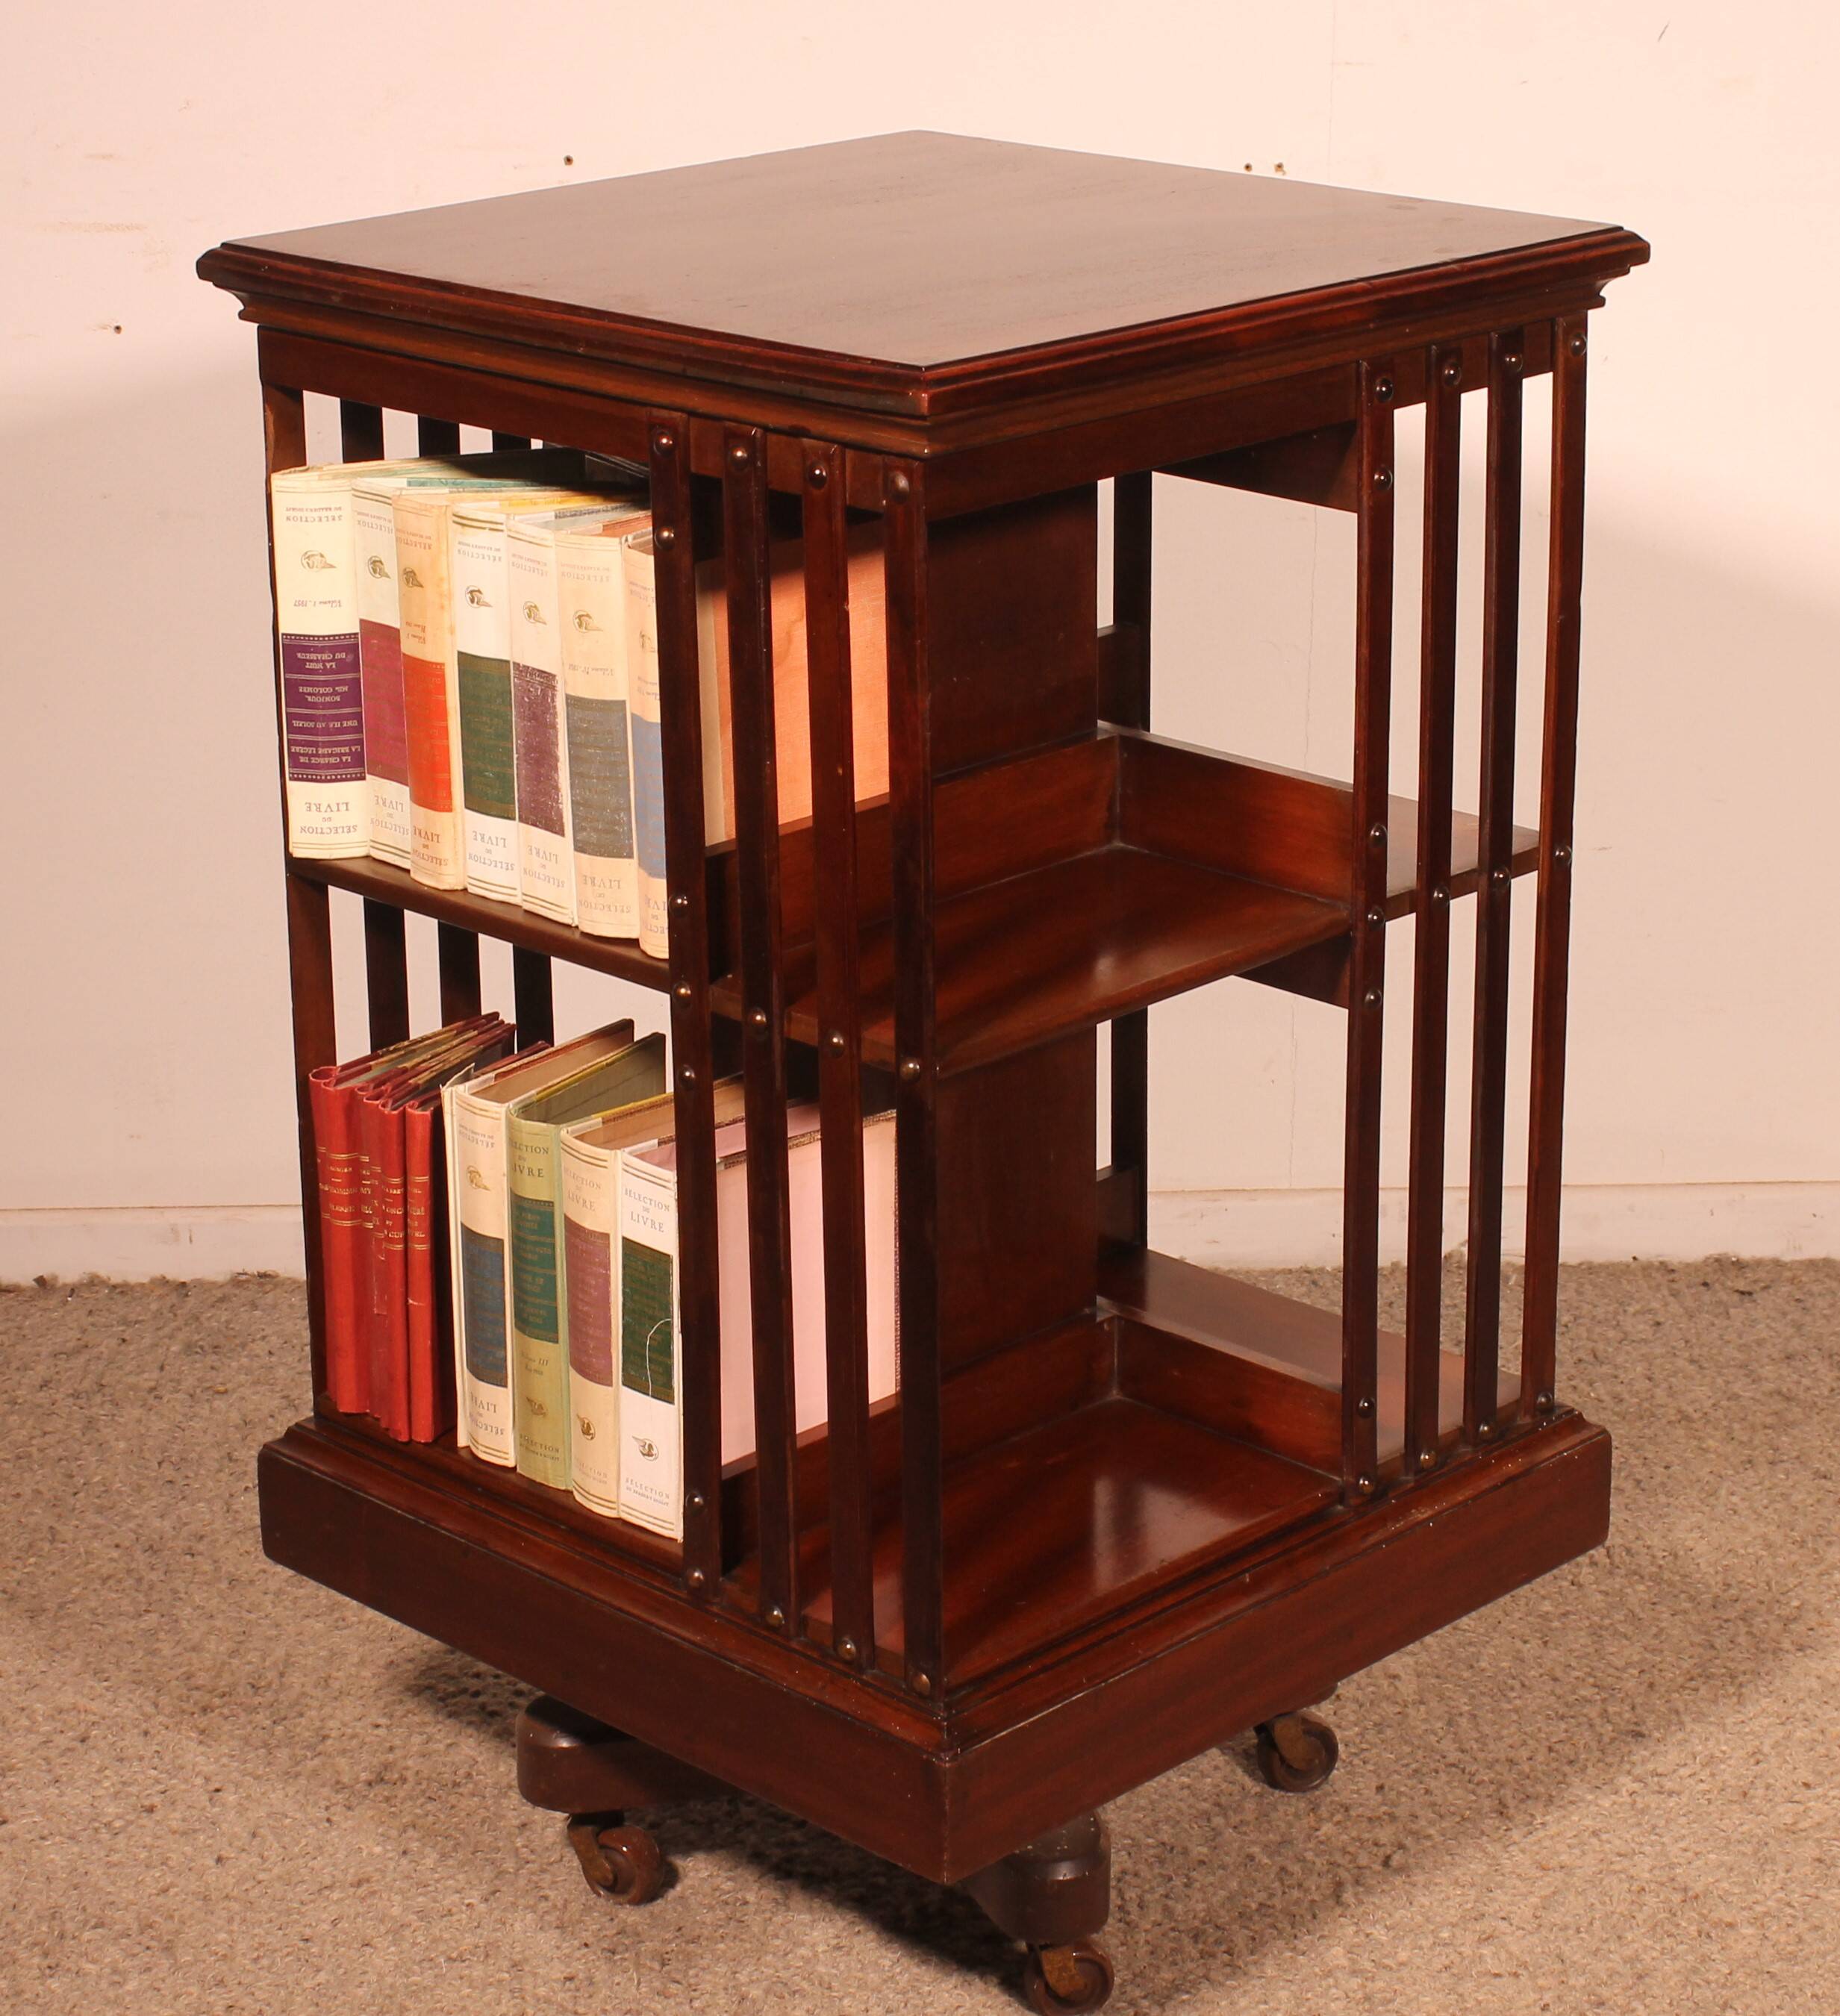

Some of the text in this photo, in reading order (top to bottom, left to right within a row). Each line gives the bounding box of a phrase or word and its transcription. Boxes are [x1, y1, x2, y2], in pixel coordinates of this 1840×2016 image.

[304, 801, 350, 812] LIVRE
[374, 793, 405, 812] LIVRE
[412, 825, 441, 843] LIVRE
[472, 830, 507, 849] LIVRE
[526, 844, 560, 865] LIVRE
[581, 874, 622, 890] LIVRE
[512, 1162, 544, 1178] IVRE
[567, 1188, 596, 1211] LIVRE
[630, 1211, 665, 1233] LIVRE
